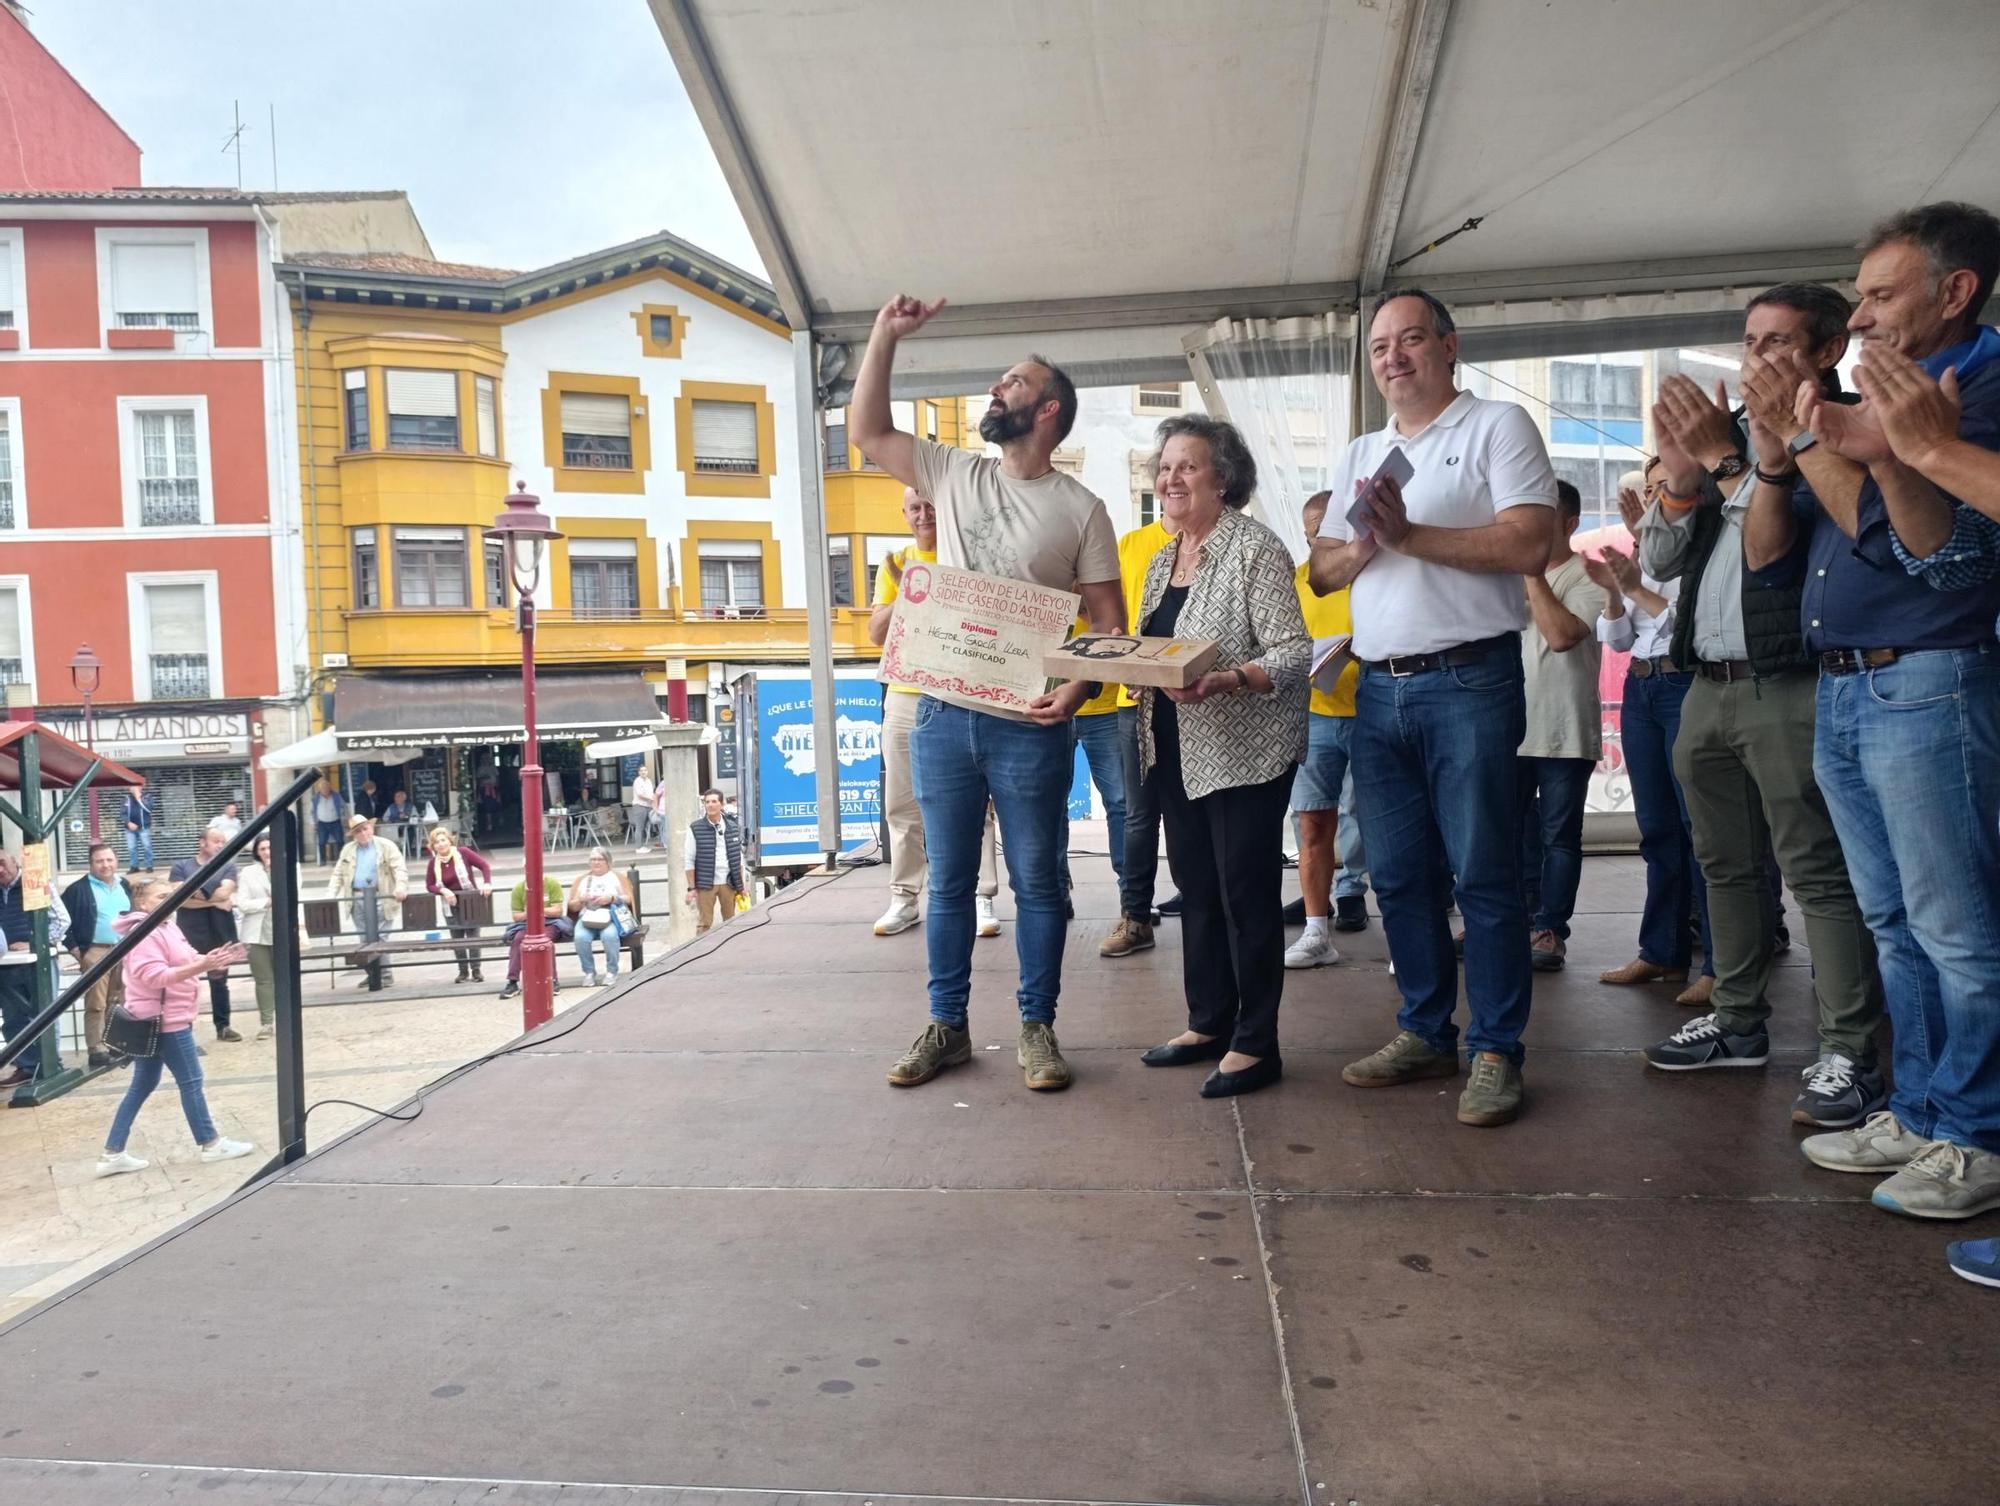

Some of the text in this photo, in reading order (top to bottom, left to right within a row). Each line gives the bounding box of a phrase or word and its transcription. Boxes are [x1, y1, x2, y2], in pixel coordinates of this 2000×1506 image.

[939, 572, 1072, 612] SELEICIÓN DE LA MEYOR
[935, 587, 965, 603] SIDRE
[968, 593, 1008, 612] CASERO
[1009, 601, 1070, 626] D'ASTURIES
[961, 622, 998, 636] Diploma
[953, 647, 1006, 665] CLASIFICADO
[794, 700, 806, 709] LE
[849, 698, 877, 706] HIELO
[54, 715, 239, 742] VILLAMANDOS
